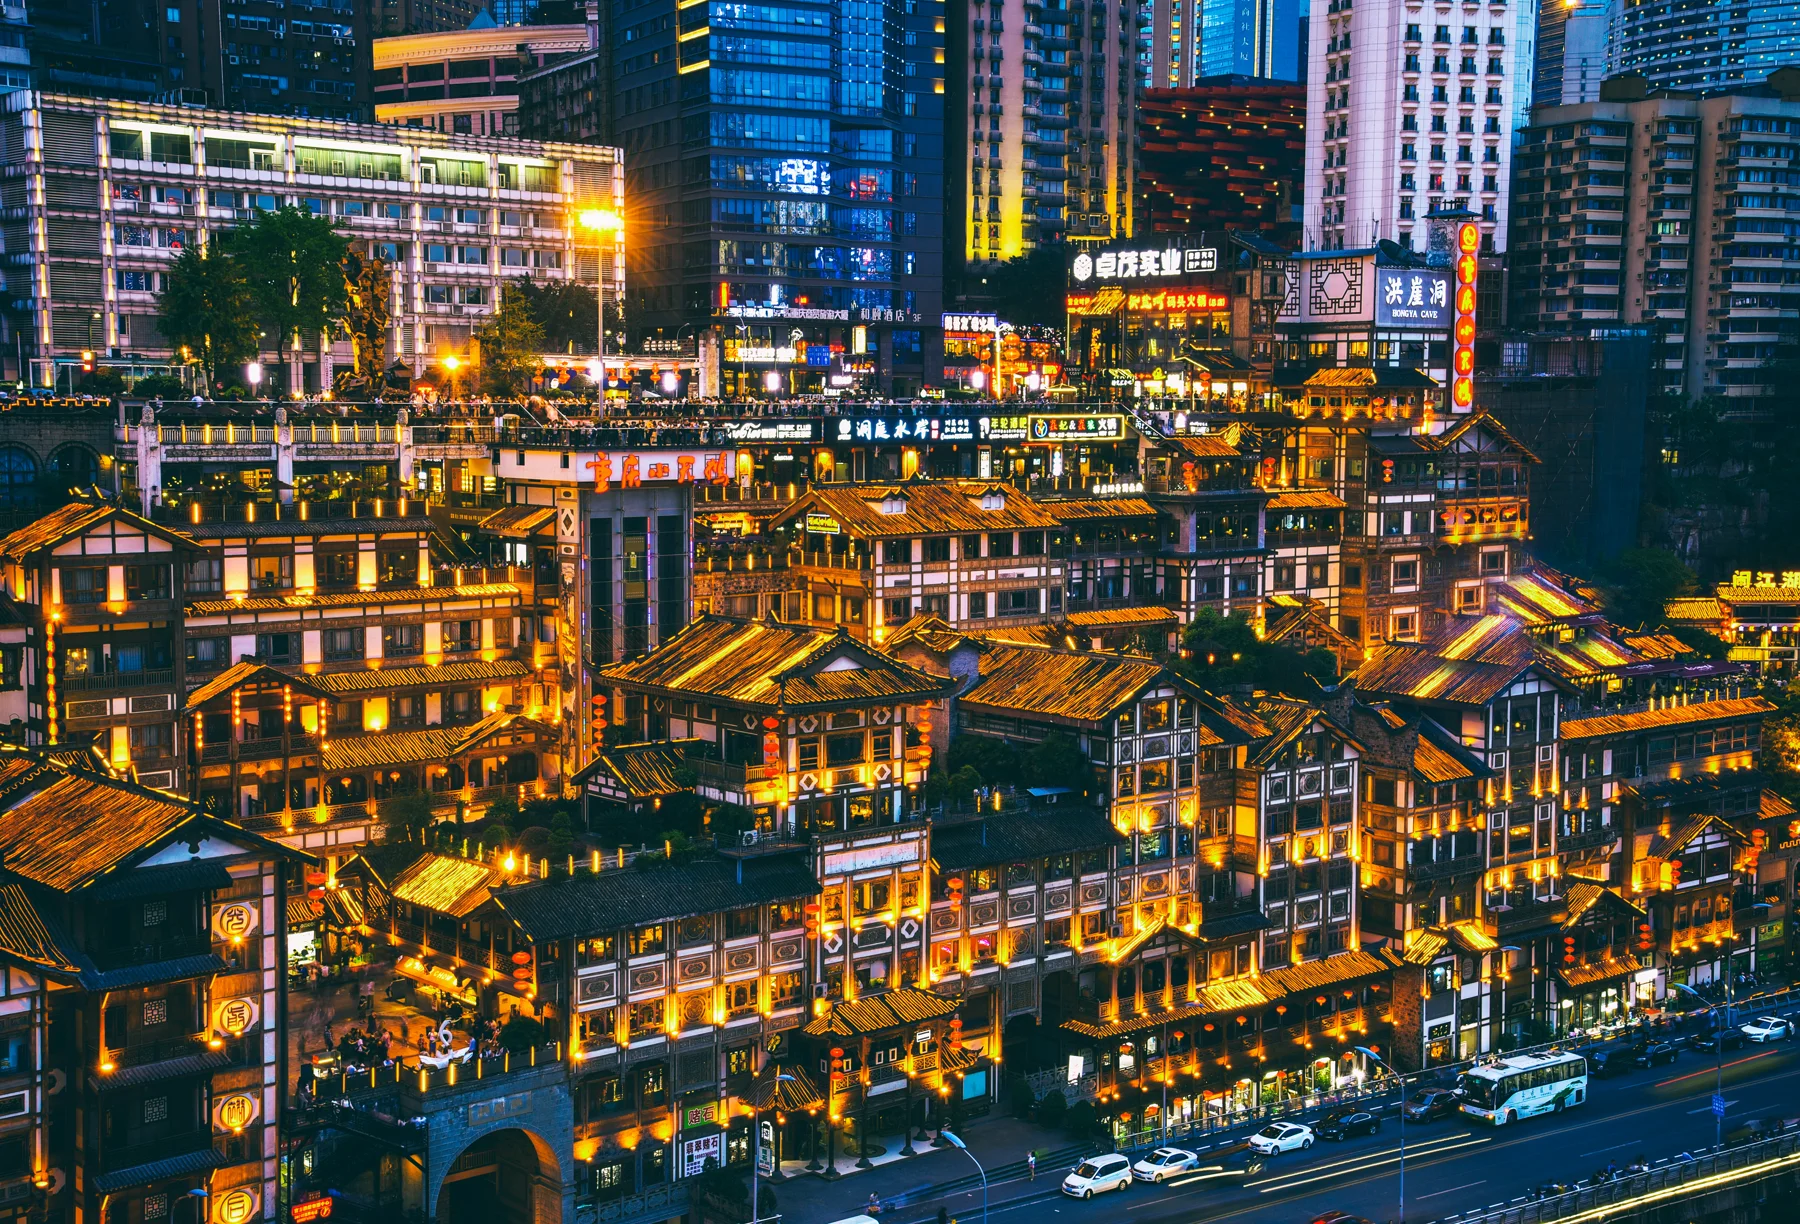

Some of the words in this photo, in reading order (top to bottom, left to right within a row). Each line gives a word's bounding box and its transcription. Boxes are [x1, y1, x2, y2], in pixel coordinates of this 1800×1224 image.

[1096, 249, 1181, 278] 卓茂实业
[1385, 275, 1447, 308] 洪崖洞
[860, 307, 905, 322] 和颐酒店
[1392, 309, 1418, 318] HONGYA
[1420, 310, 1438, 319] CAVE
[856, 419, 929, 441] 洞庭水岸
[688, 1106, 715, 1125] 赌石
